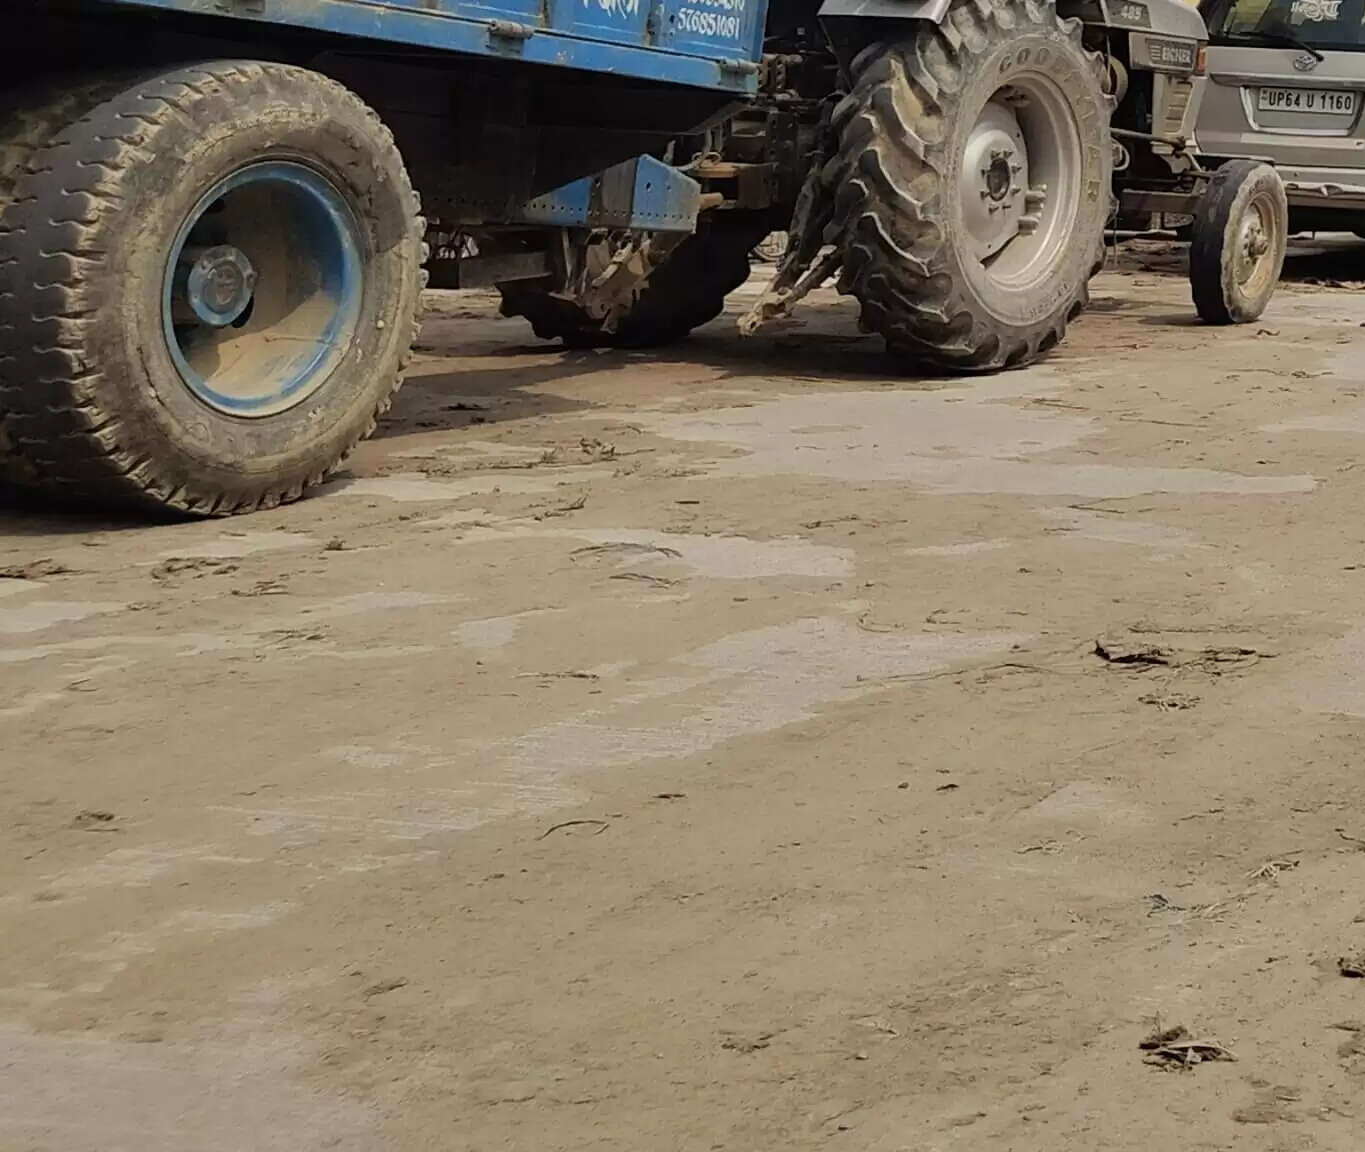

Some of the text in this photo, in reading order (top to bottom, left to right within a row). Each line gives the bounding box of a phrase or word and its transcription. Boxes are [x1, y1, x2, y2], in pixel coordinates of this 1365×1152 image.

[1269, 89, 1352, 111] UP64 U 1160
